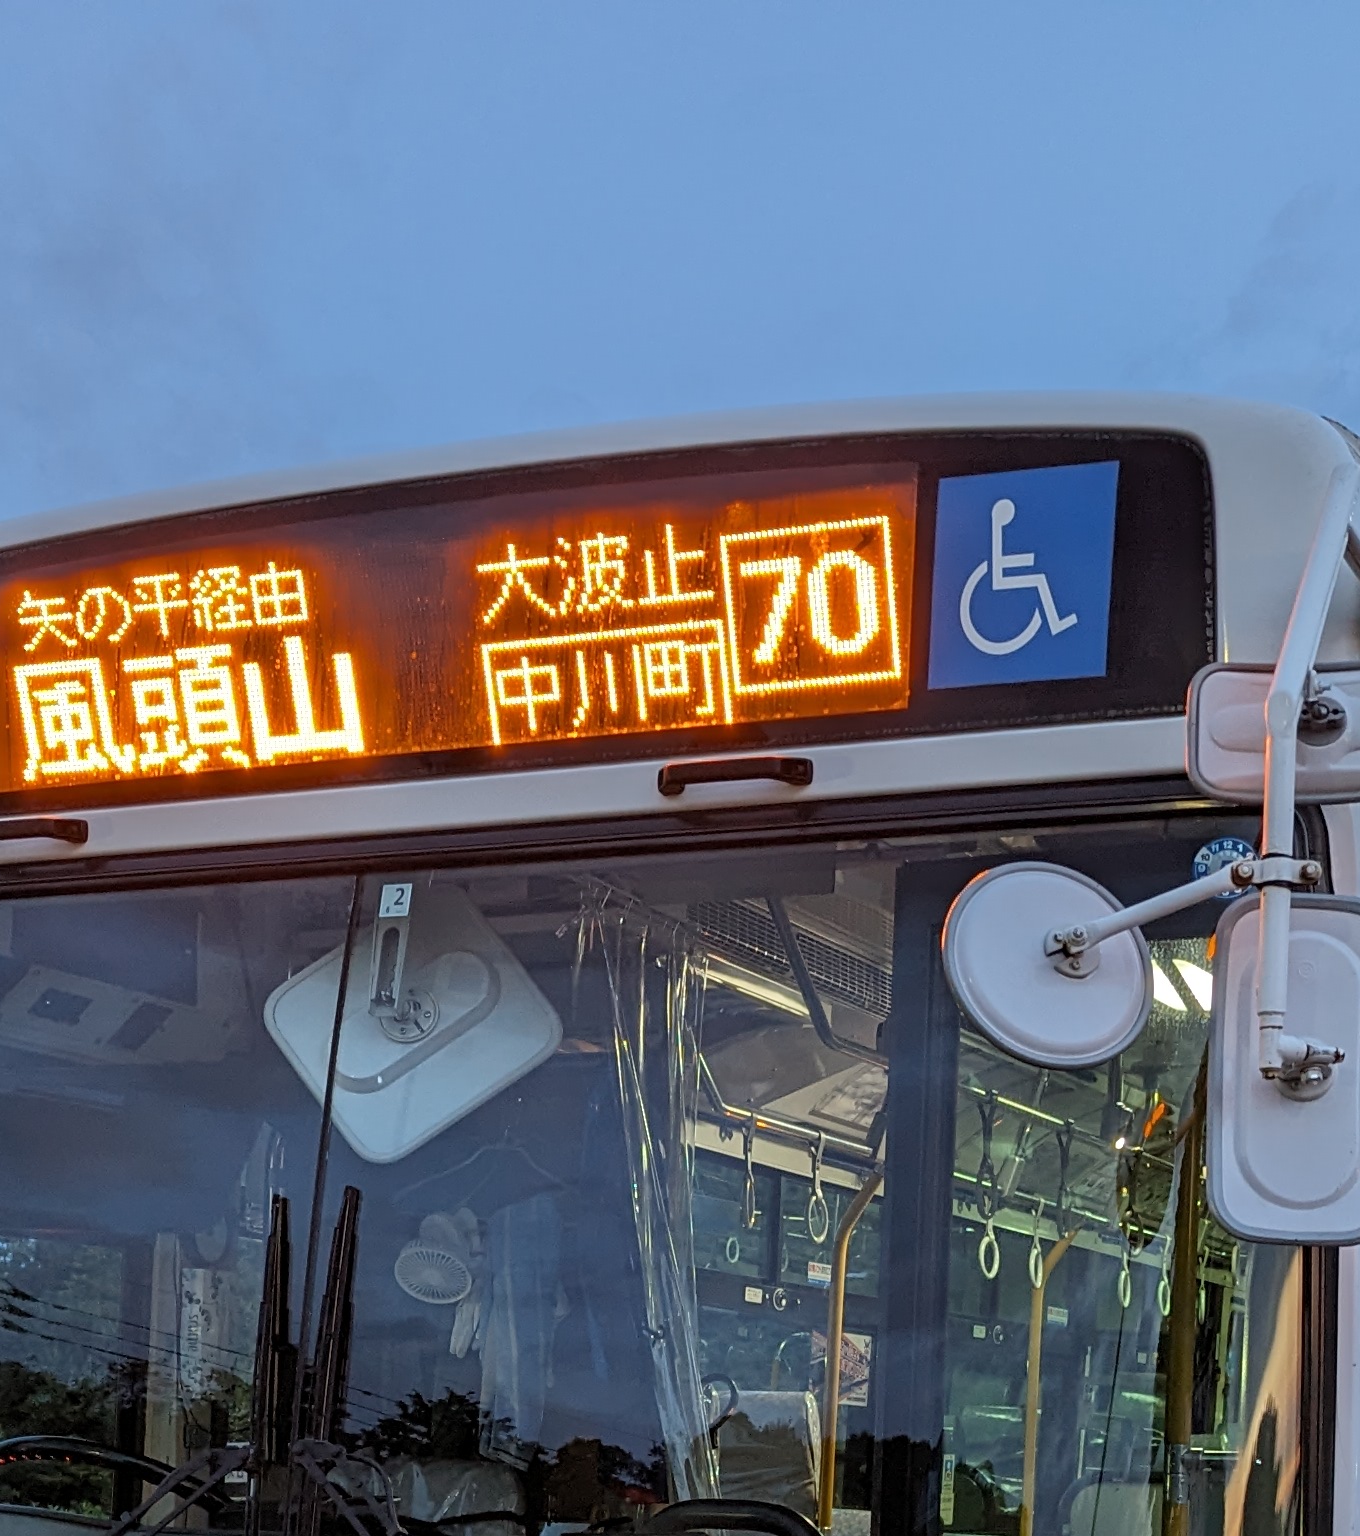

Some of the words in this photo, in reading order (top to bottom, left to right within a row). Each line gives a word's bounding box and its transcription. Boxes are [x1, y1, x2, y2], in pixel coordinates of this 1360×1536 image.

[17, 562, 309, 652] 矢の平経由
[477, 524, 714, 625] 大波止
[739, 550, 875, 664] 70
[14, 636, 365, 782] 風頭山
[495, 640, 714, 731] 中川町
[394, 888, 405, 906] 2
